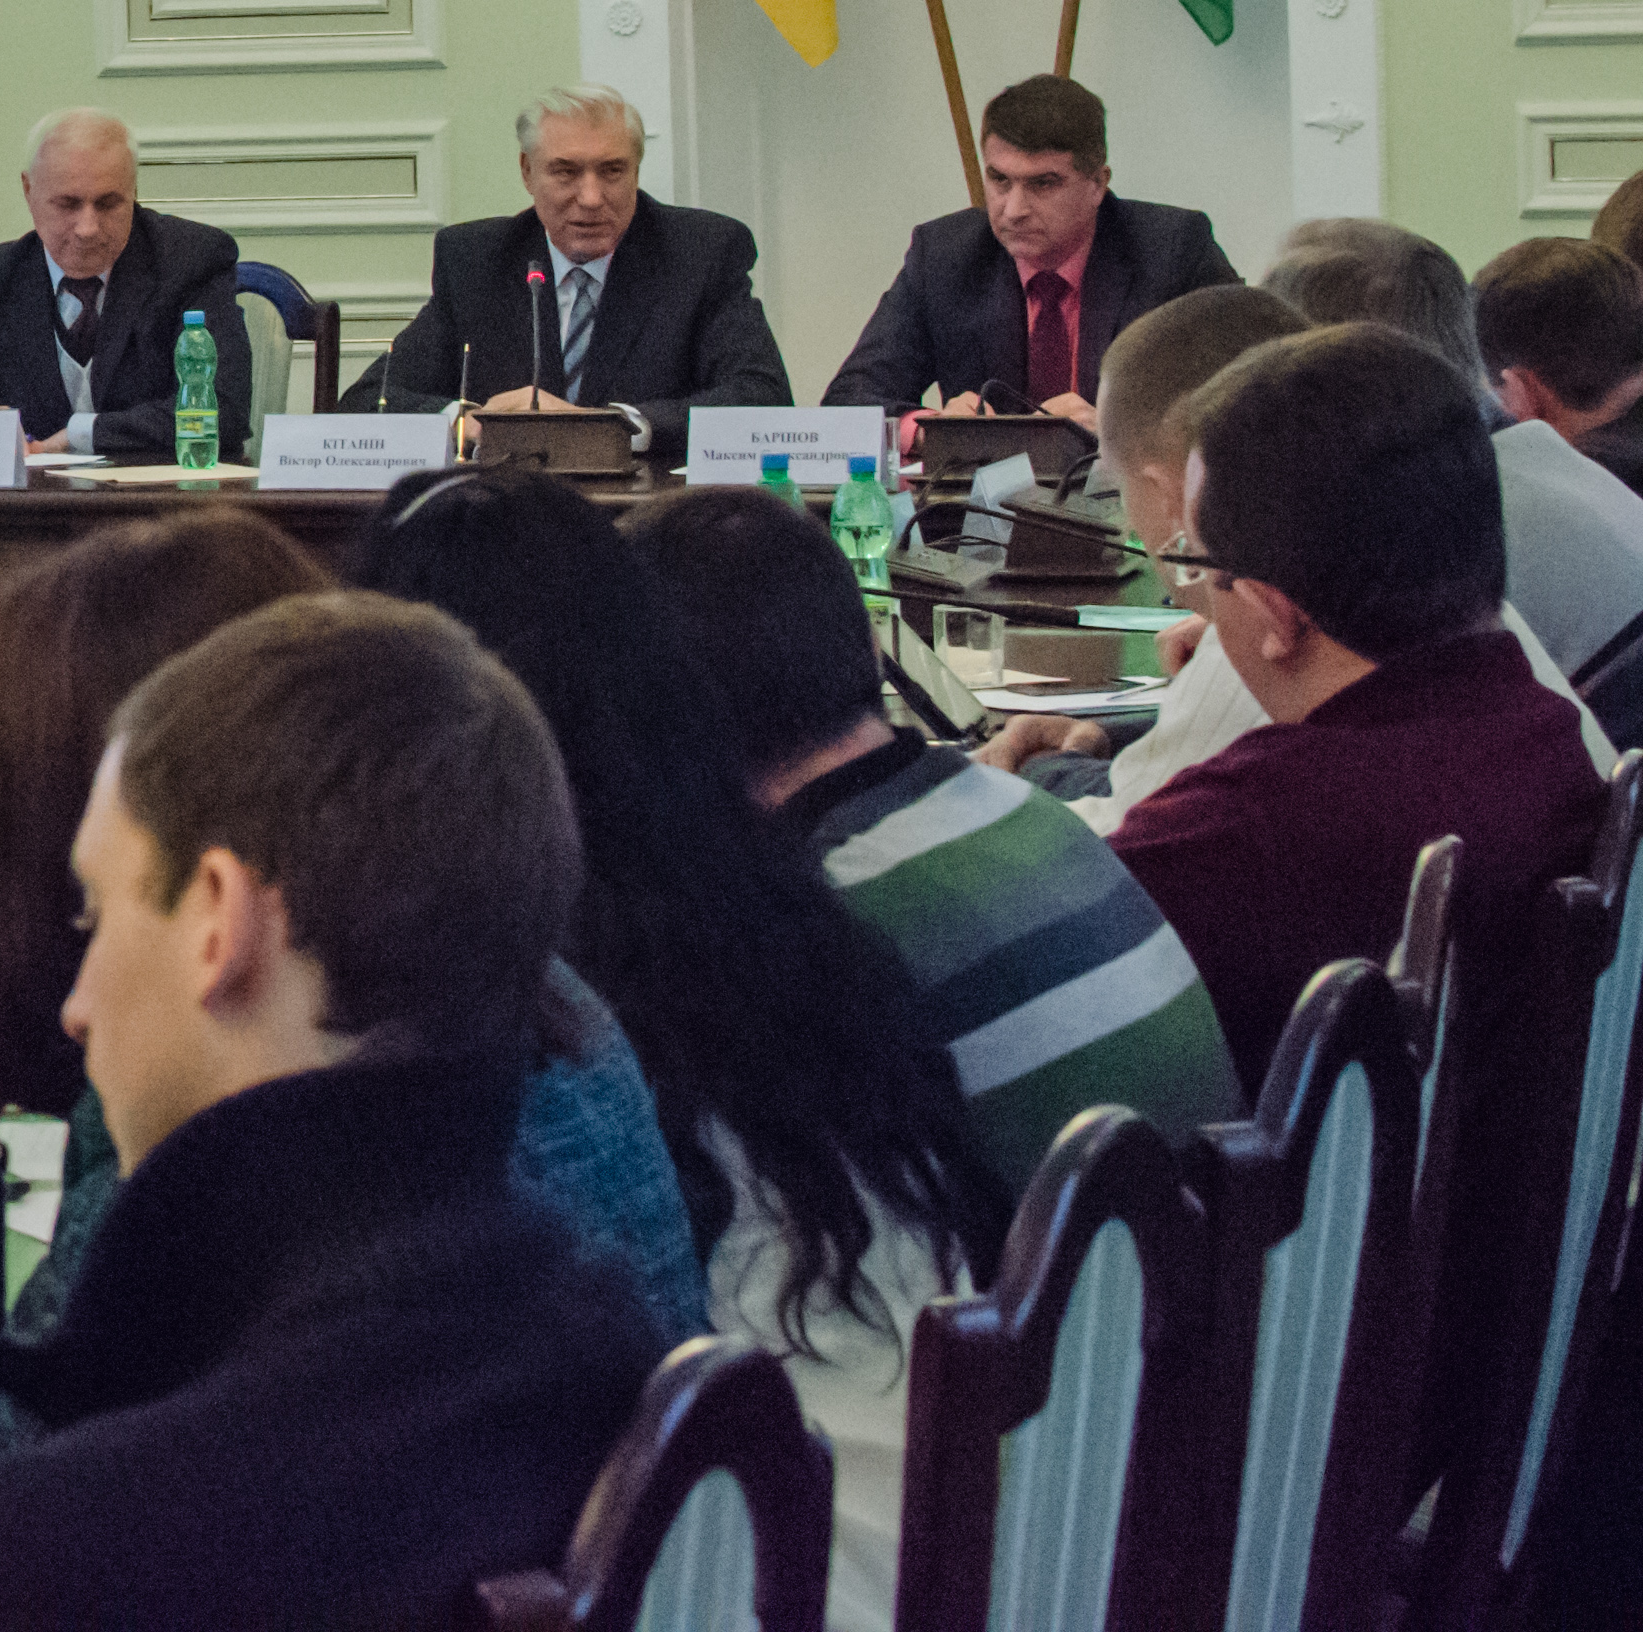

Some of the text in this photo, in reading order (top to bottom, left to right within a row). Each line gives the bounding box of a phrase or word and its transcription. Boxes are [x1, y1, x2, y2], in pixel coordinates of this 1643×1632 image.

[278, 454, 427, 469] Віктор Олександрович
[702, 449, 757, 461] Максим
